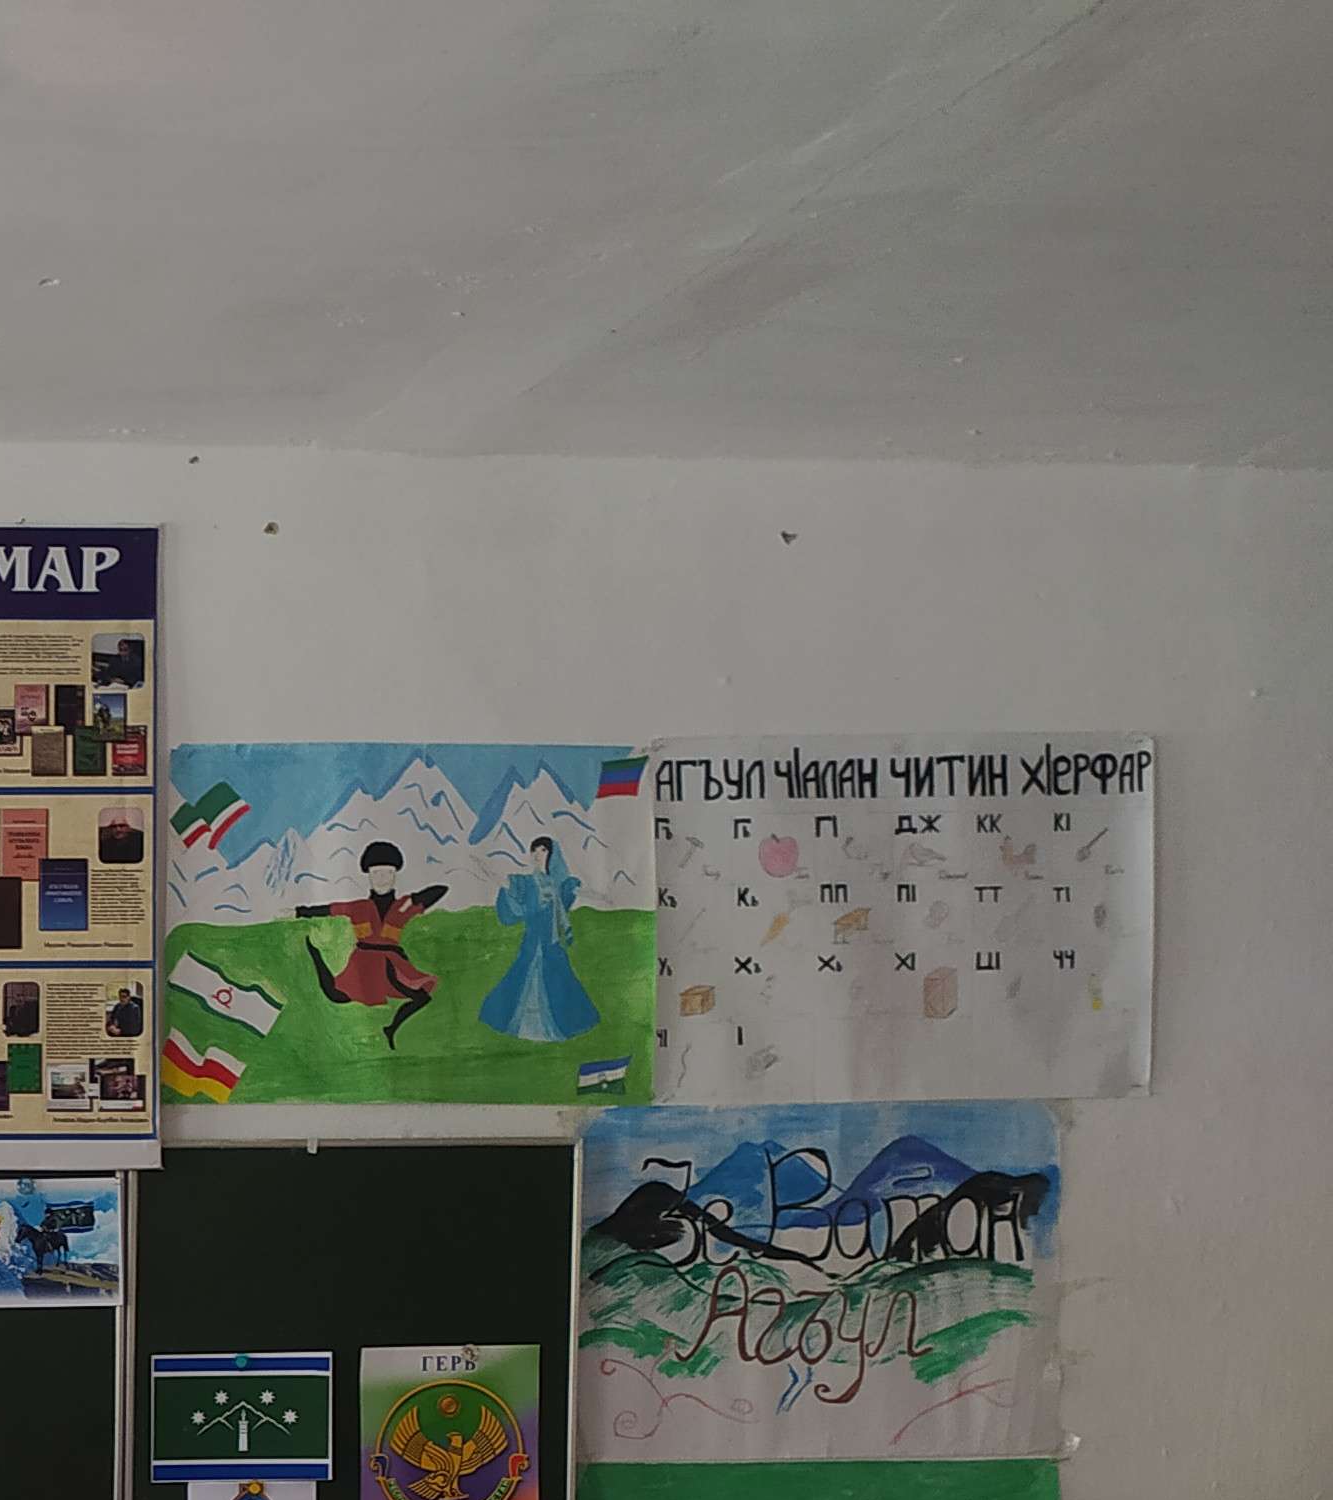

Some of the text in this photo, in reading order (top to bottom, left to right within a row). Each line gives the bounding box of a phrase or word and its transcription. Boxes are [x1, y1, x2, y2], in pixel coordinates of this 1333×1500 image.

[656, 759, 766, 802] АГЪУЛ
[890, 753, 1009, 798] ЧИТИН
[894, 814, 941, 834] ДЖ
[976, 813, 1002, 833] КК
[819, 884, 848, 903] ПП
[974, 886, 1002, 903] ТТ
[1052, 950, 1075, 970] ЧЧ
